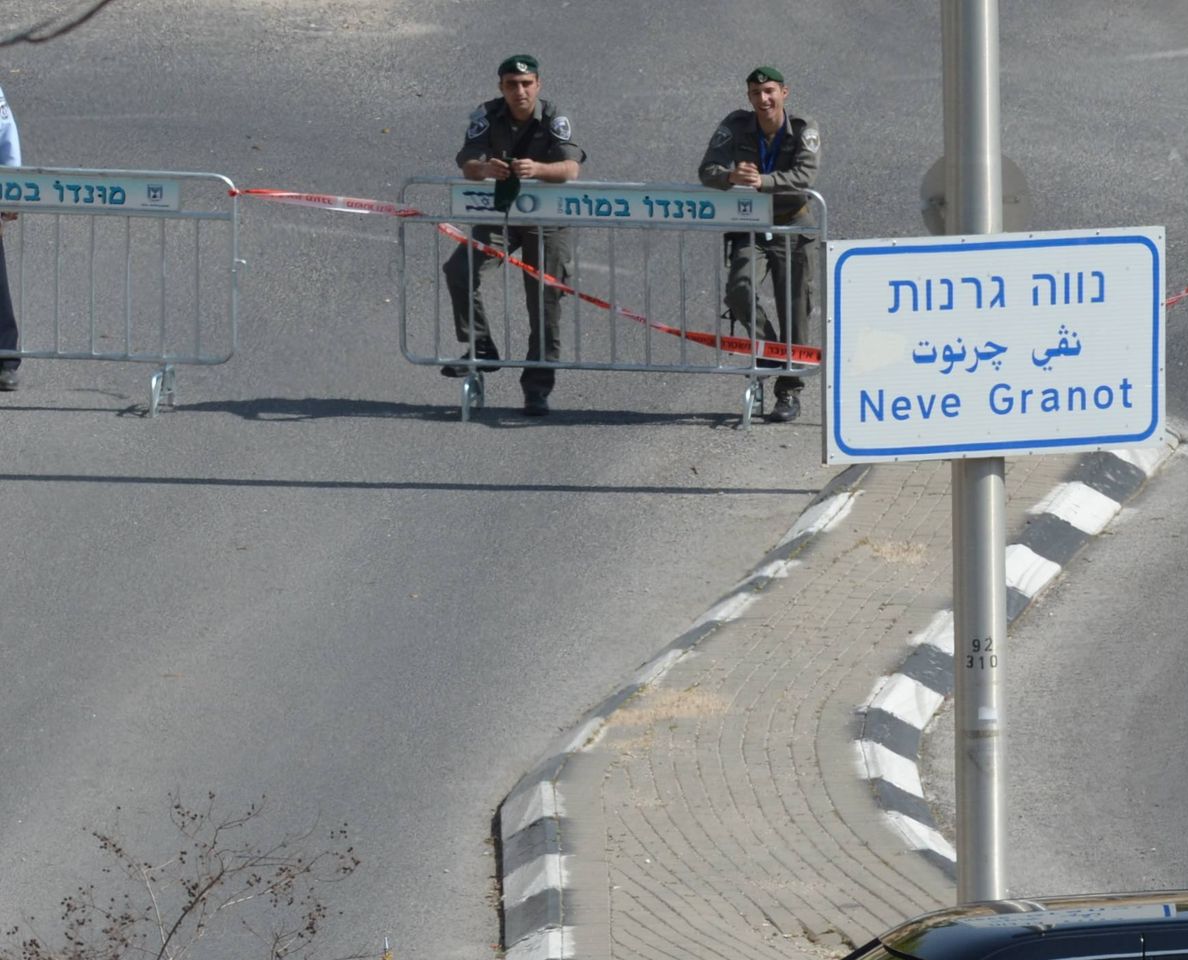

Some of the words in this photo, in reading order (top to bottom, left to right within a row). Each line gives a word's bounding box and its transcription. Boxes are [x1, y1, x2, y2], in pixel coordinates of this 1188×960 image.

[0, 182, 41, 202] במ
[887, 275, 1006, 313] גרנות
[1032, 269, 1105, 306] נווה
[859, 389, 961, 423] Neve
[988, 377, 1133, 415] Granot
[972, 637, 993, 653] 92
[966, 655, 998, 670] 310
